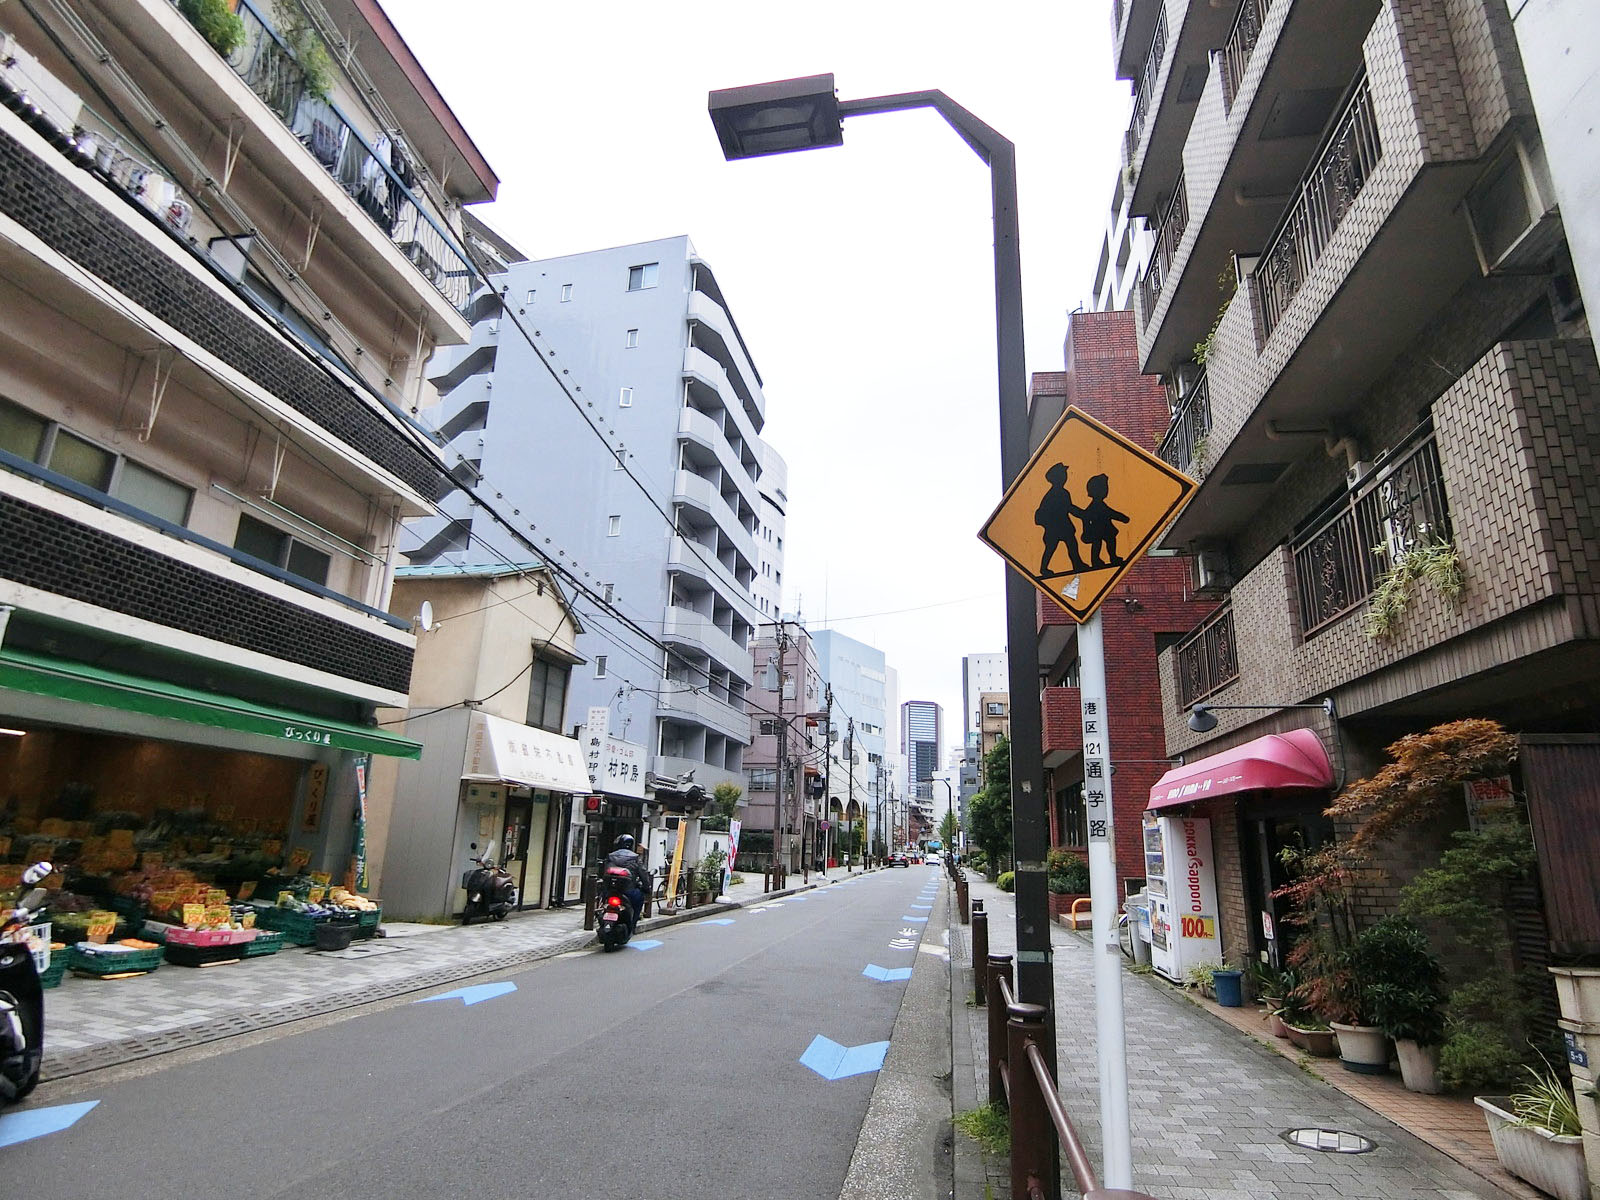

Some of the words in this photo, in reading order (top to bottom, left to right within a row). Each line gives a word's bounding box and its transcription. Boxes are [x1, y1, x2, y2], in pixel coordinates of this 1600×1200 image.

[1084, 702, 1098, 733] 港区
[1085, 742, 1101, 755] 121
[606, 757, 639, 784] 村印房
[1086, 761, 1106, 837] 通学路
